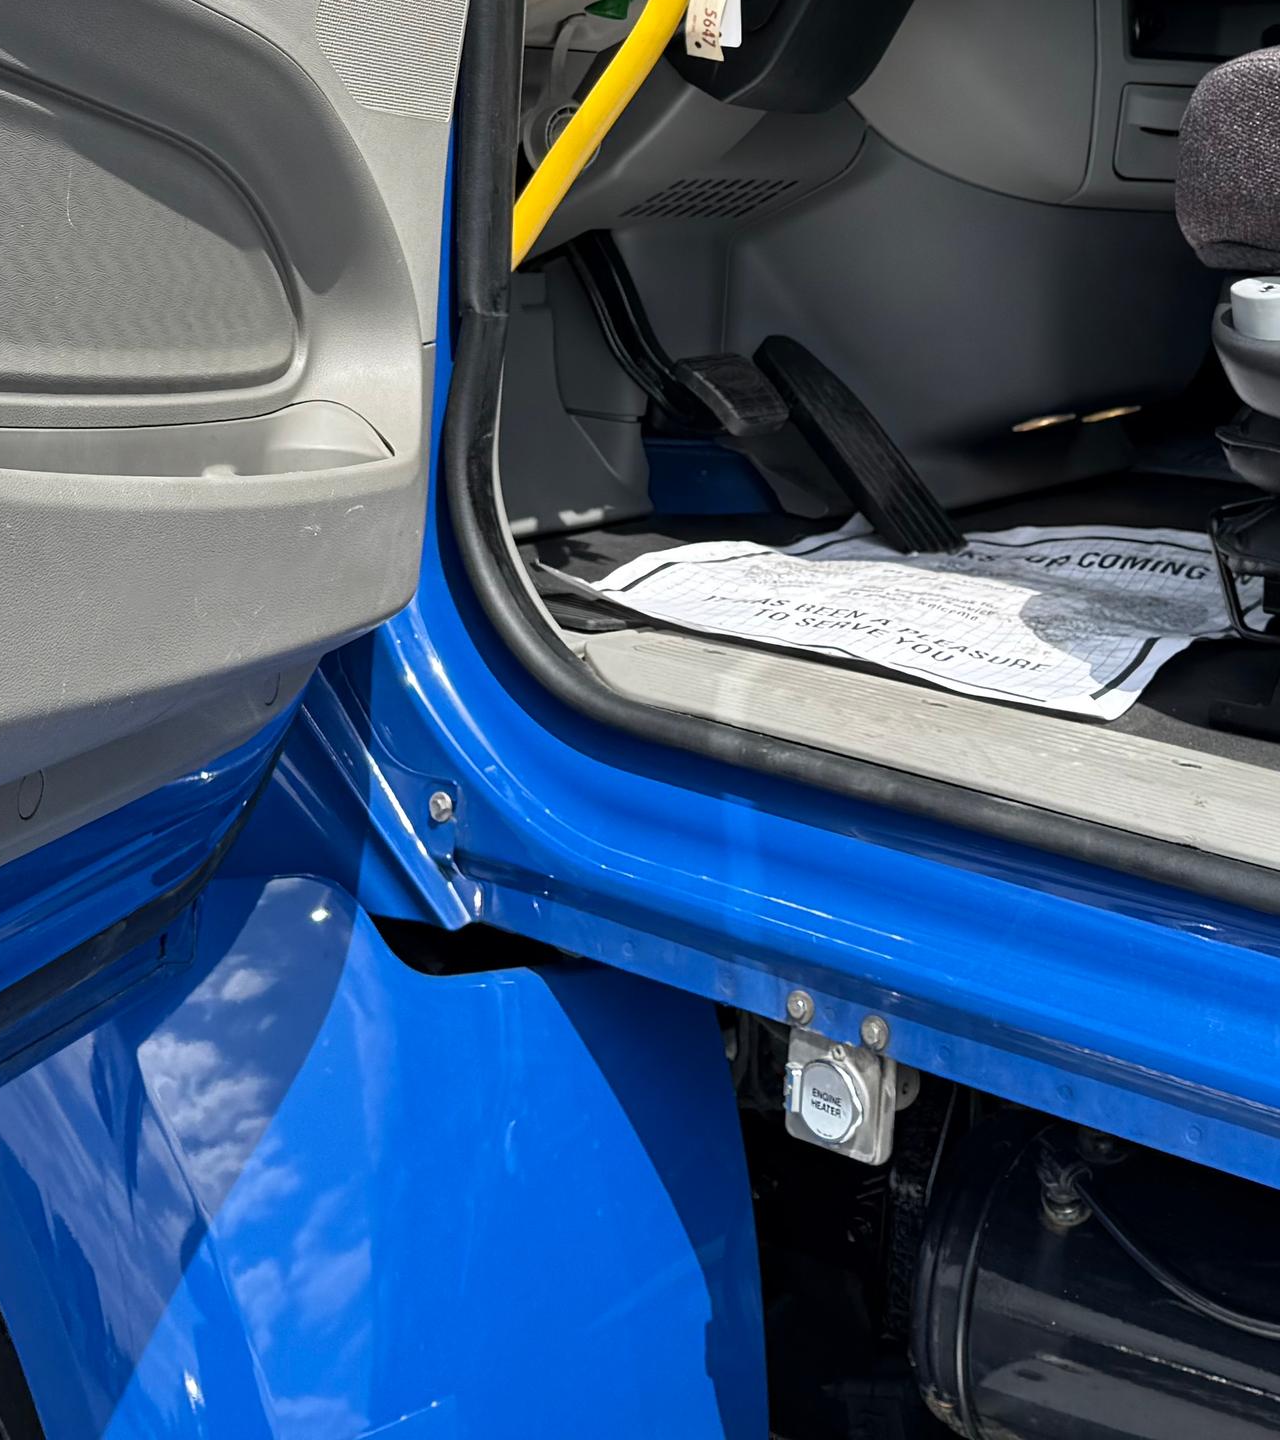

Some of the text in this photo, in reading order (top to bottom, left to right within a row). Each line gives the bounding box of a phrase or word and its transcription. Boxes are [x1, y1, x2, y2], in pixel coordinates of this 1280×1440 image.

[1077, 551, 1211, 581] COMING
[753, 608, 956, 662] TO SERVE YOU
[795, 603, 871, 619] BEEN
[874, 618, 898, 627] A
[898, 627, 1052, 673] PLEASURE
[810, 1098, 842, 1119] HEATER
[812, 1087, 842, 1107] ENGINE
